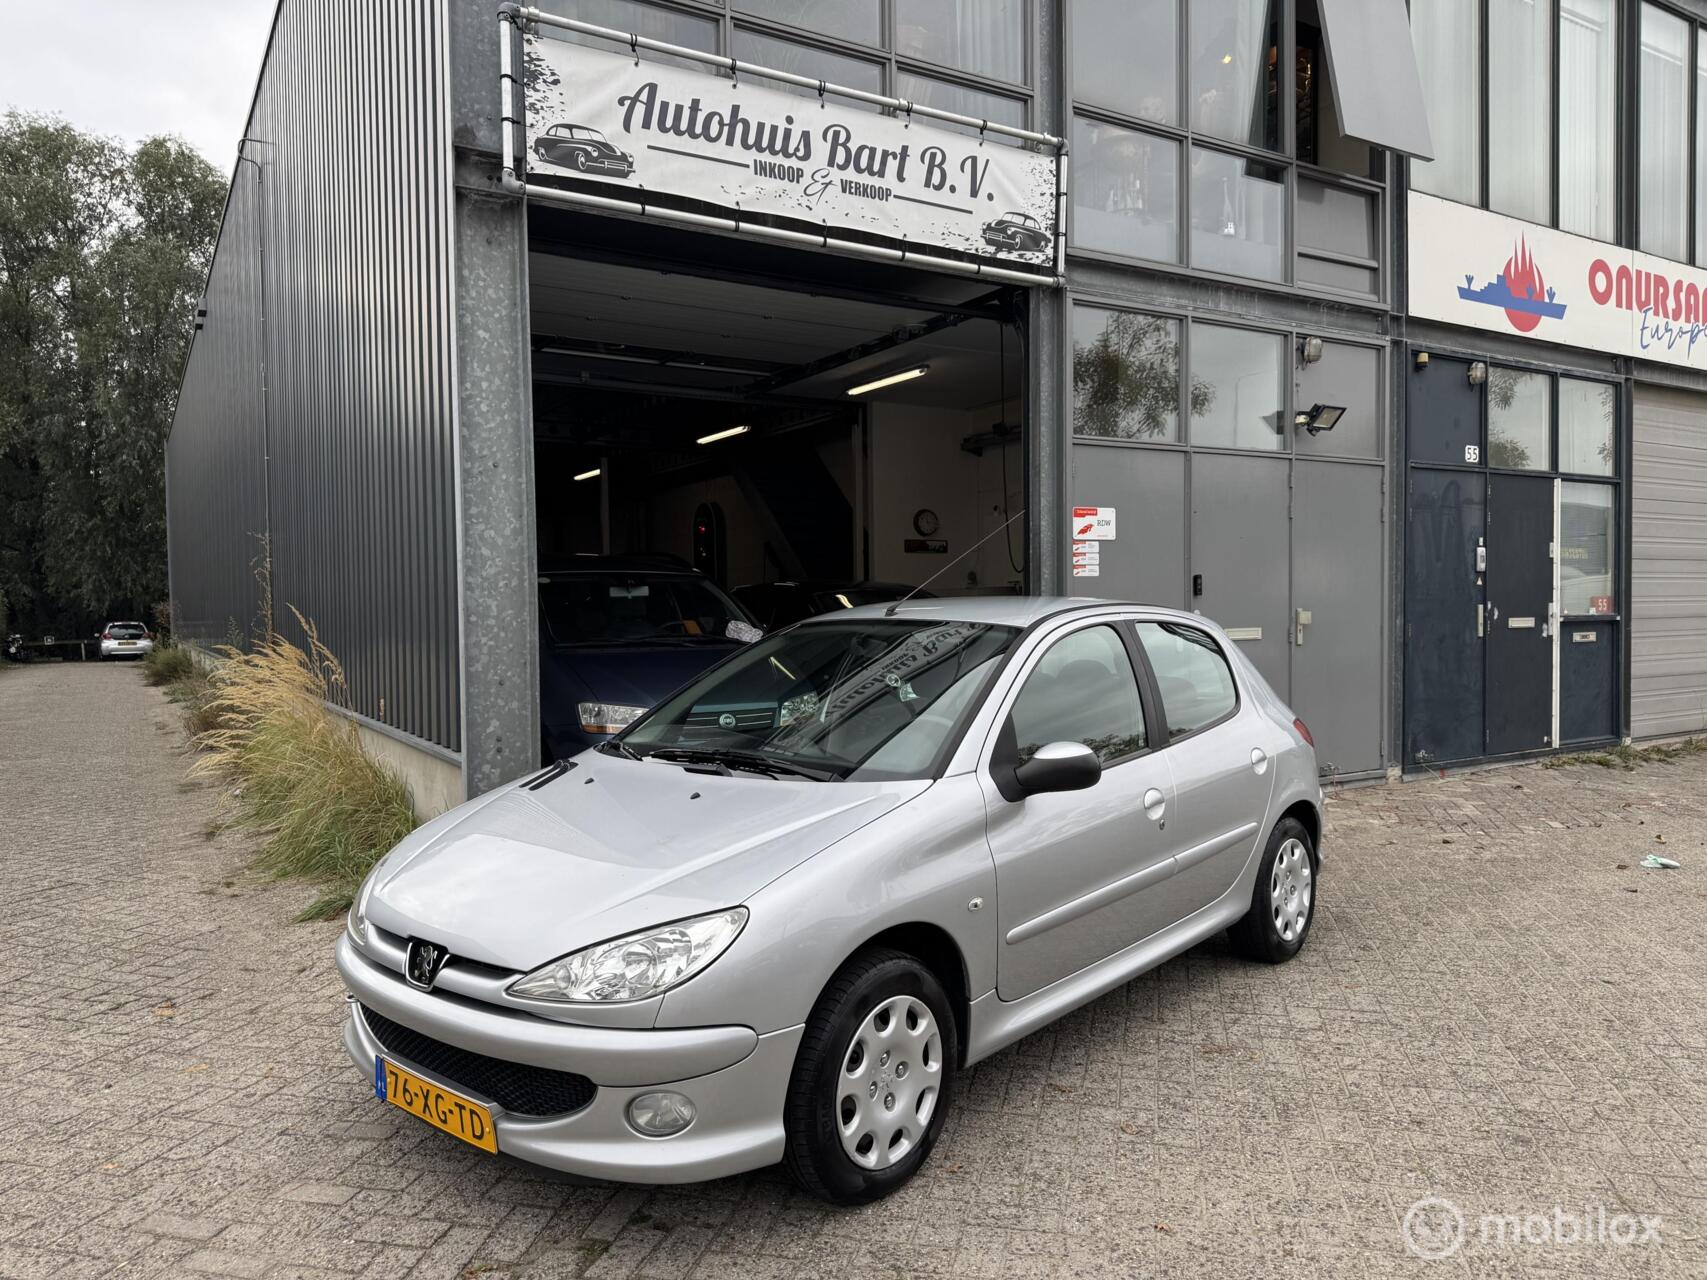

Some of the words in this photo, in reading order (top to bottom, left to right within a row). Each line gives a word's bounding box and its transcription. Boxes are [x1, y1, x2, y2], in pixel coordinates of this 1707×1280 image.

[617, 82, 812, 162] Autohuis
[822, 123, 910, 183] Bart
[920, 145, 994, 202] B.V.
[753, 158, 804, 184] INKOOP
[840, 178, 892, 202] VERKOOP
[1588, 258, 1707, 327] ONURSA
[1467, 447, 1478, 461] 55
[1598, 598, 1607, 611] 55
[389, 1070, 485, 1141] 76-XG-TD
